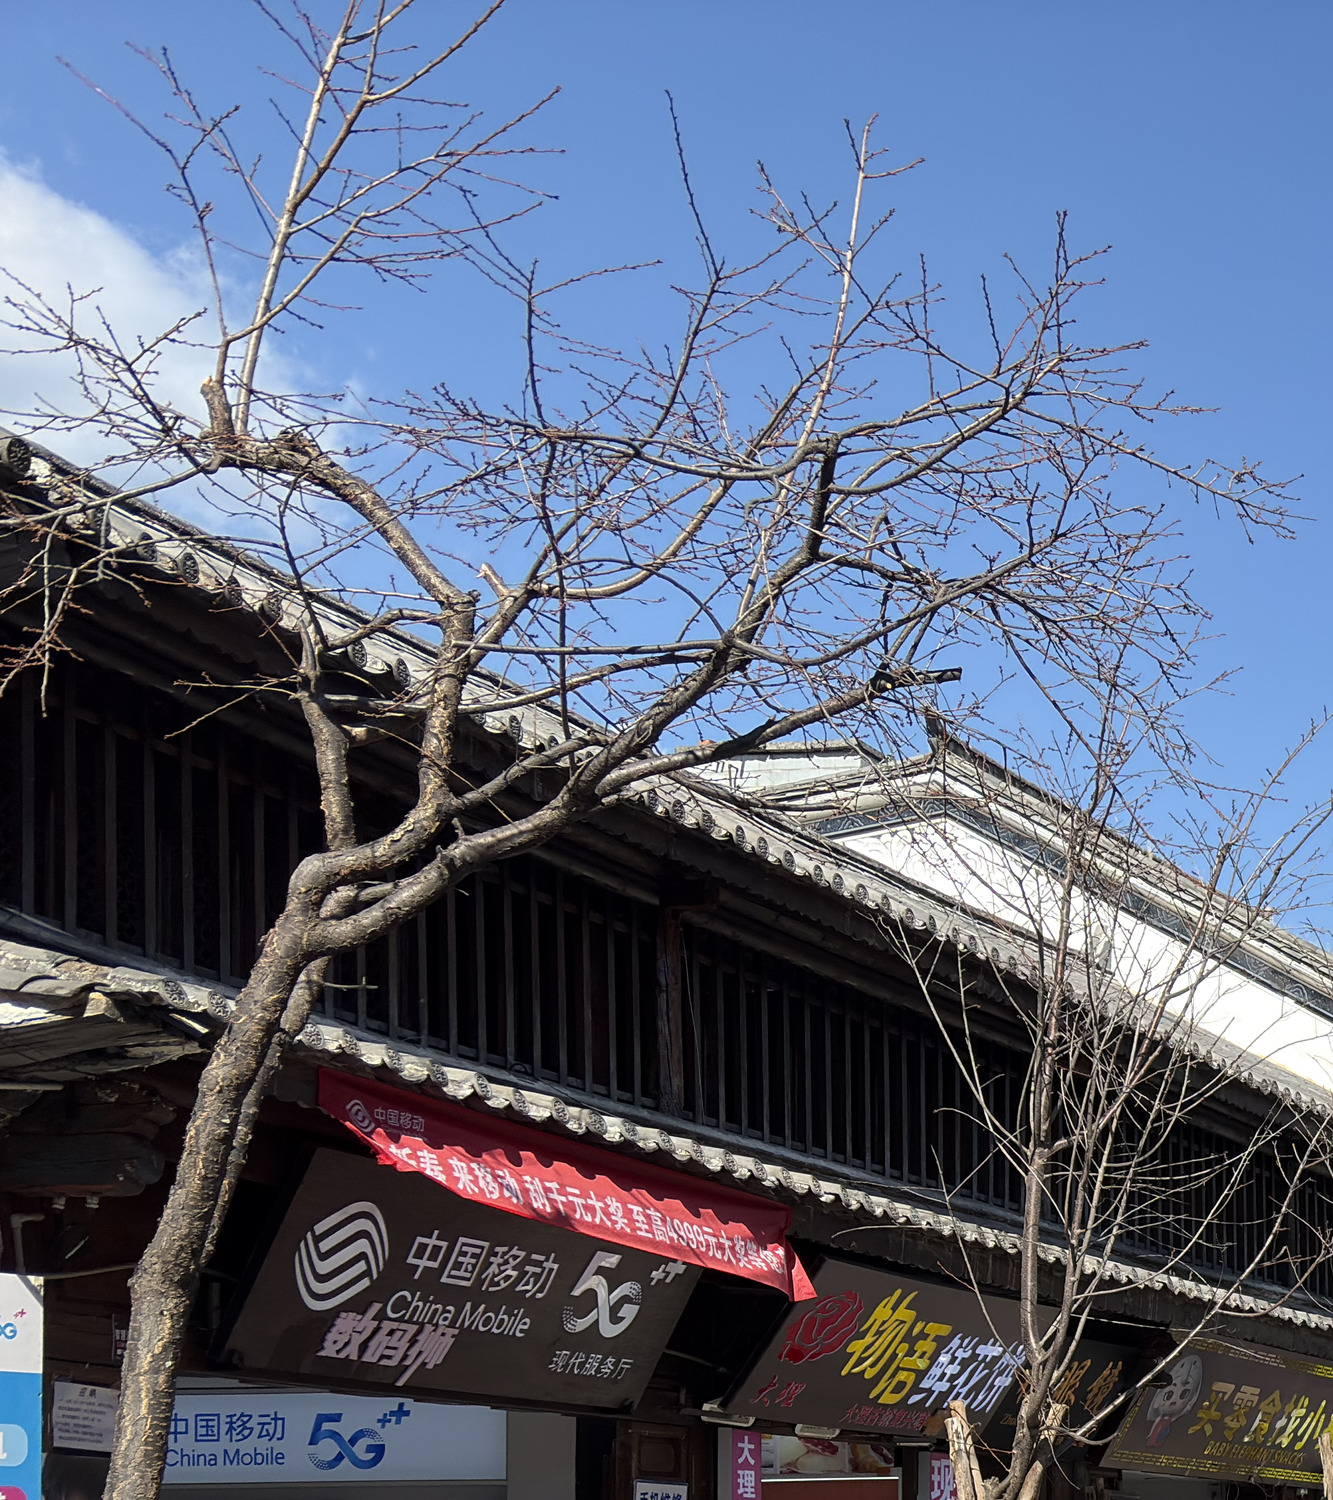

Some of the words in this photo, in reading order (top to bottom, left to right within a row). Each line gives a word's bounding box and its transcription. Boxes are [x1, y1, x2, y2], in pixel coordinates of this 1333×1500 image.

[451, 1158, 523, 1203] 来移动
[529, 1178, 631, 1235] 刮千元大奖
[406, 1229, 560, 1299] 中国移动
[386, 1290, 452, 1327] China
[457, 1302, 531, 1338] Mobile
[548, 1350, 634, 1380] 现代服务厅
[751, 1375, 806, 1407] 大理
[168, 1411, 286, 1443] 中国移动
[307, 1413, 386, 1470] 5G
[165, 1448, 217, 1467] China
[223, 1447, 285, 1467] Mobile
[1203, 1440, 1231, 1457] BABY
[1229, 1442, 1275, 1462] ELEPHANT
[1271, 1449, 1307, 1468] SNACKS
